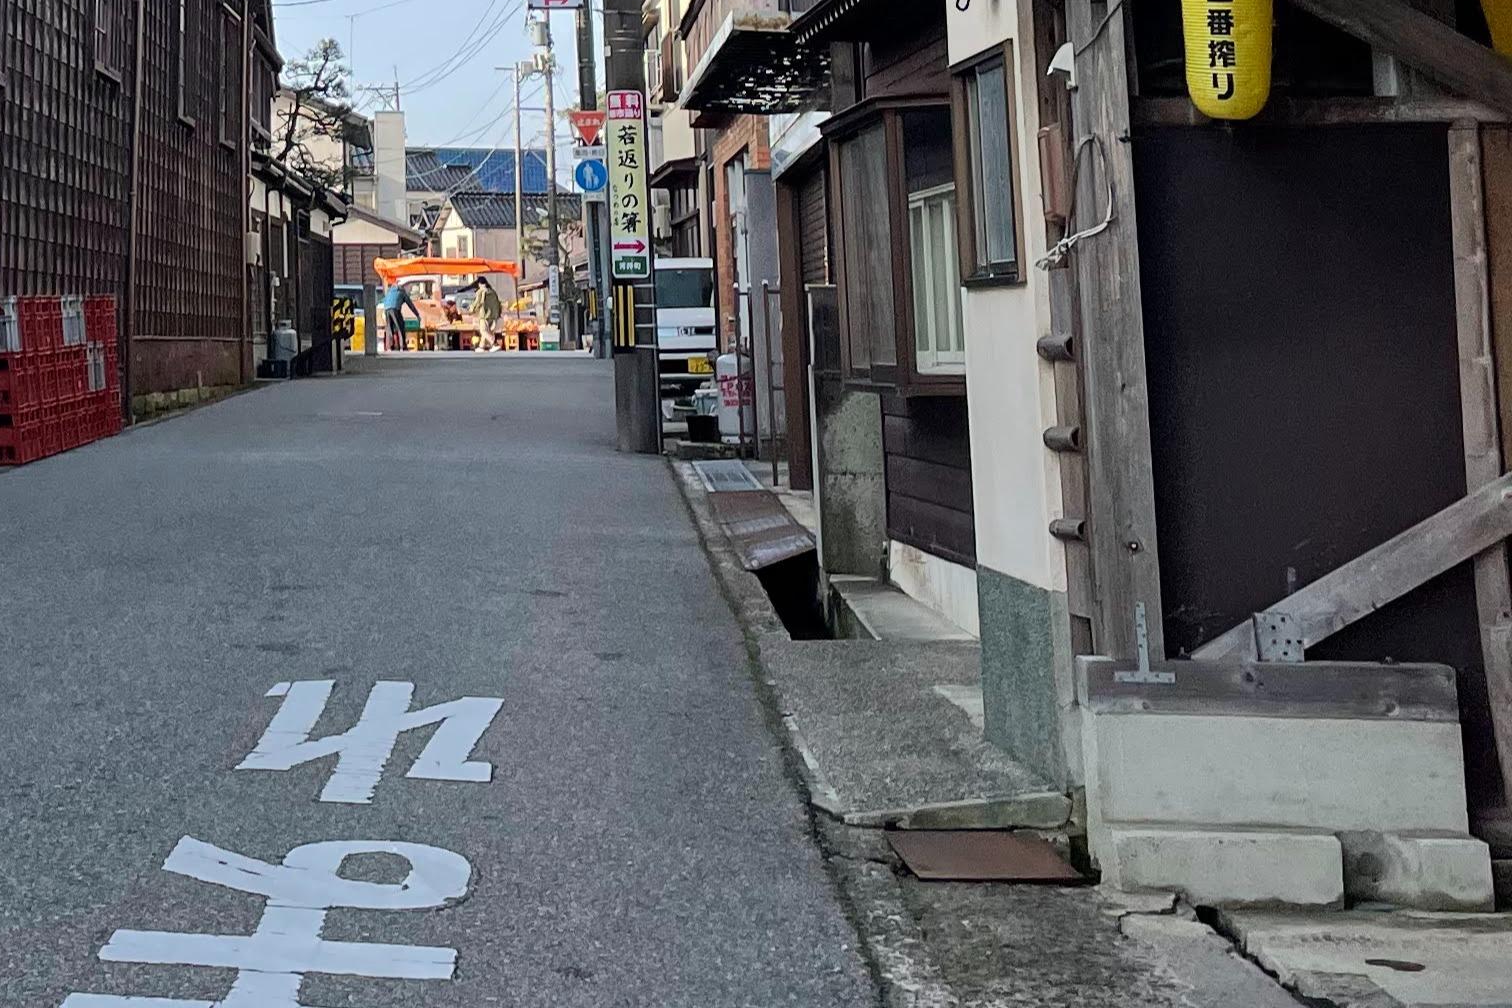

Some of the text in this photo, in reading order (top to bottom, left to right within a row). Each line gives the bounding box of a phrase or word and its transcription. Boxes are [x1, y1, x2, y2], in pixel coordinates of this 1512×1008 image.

[577, 118, 601, 127] 止まれ
[617, 125, 642, 234] 若返りの箸
